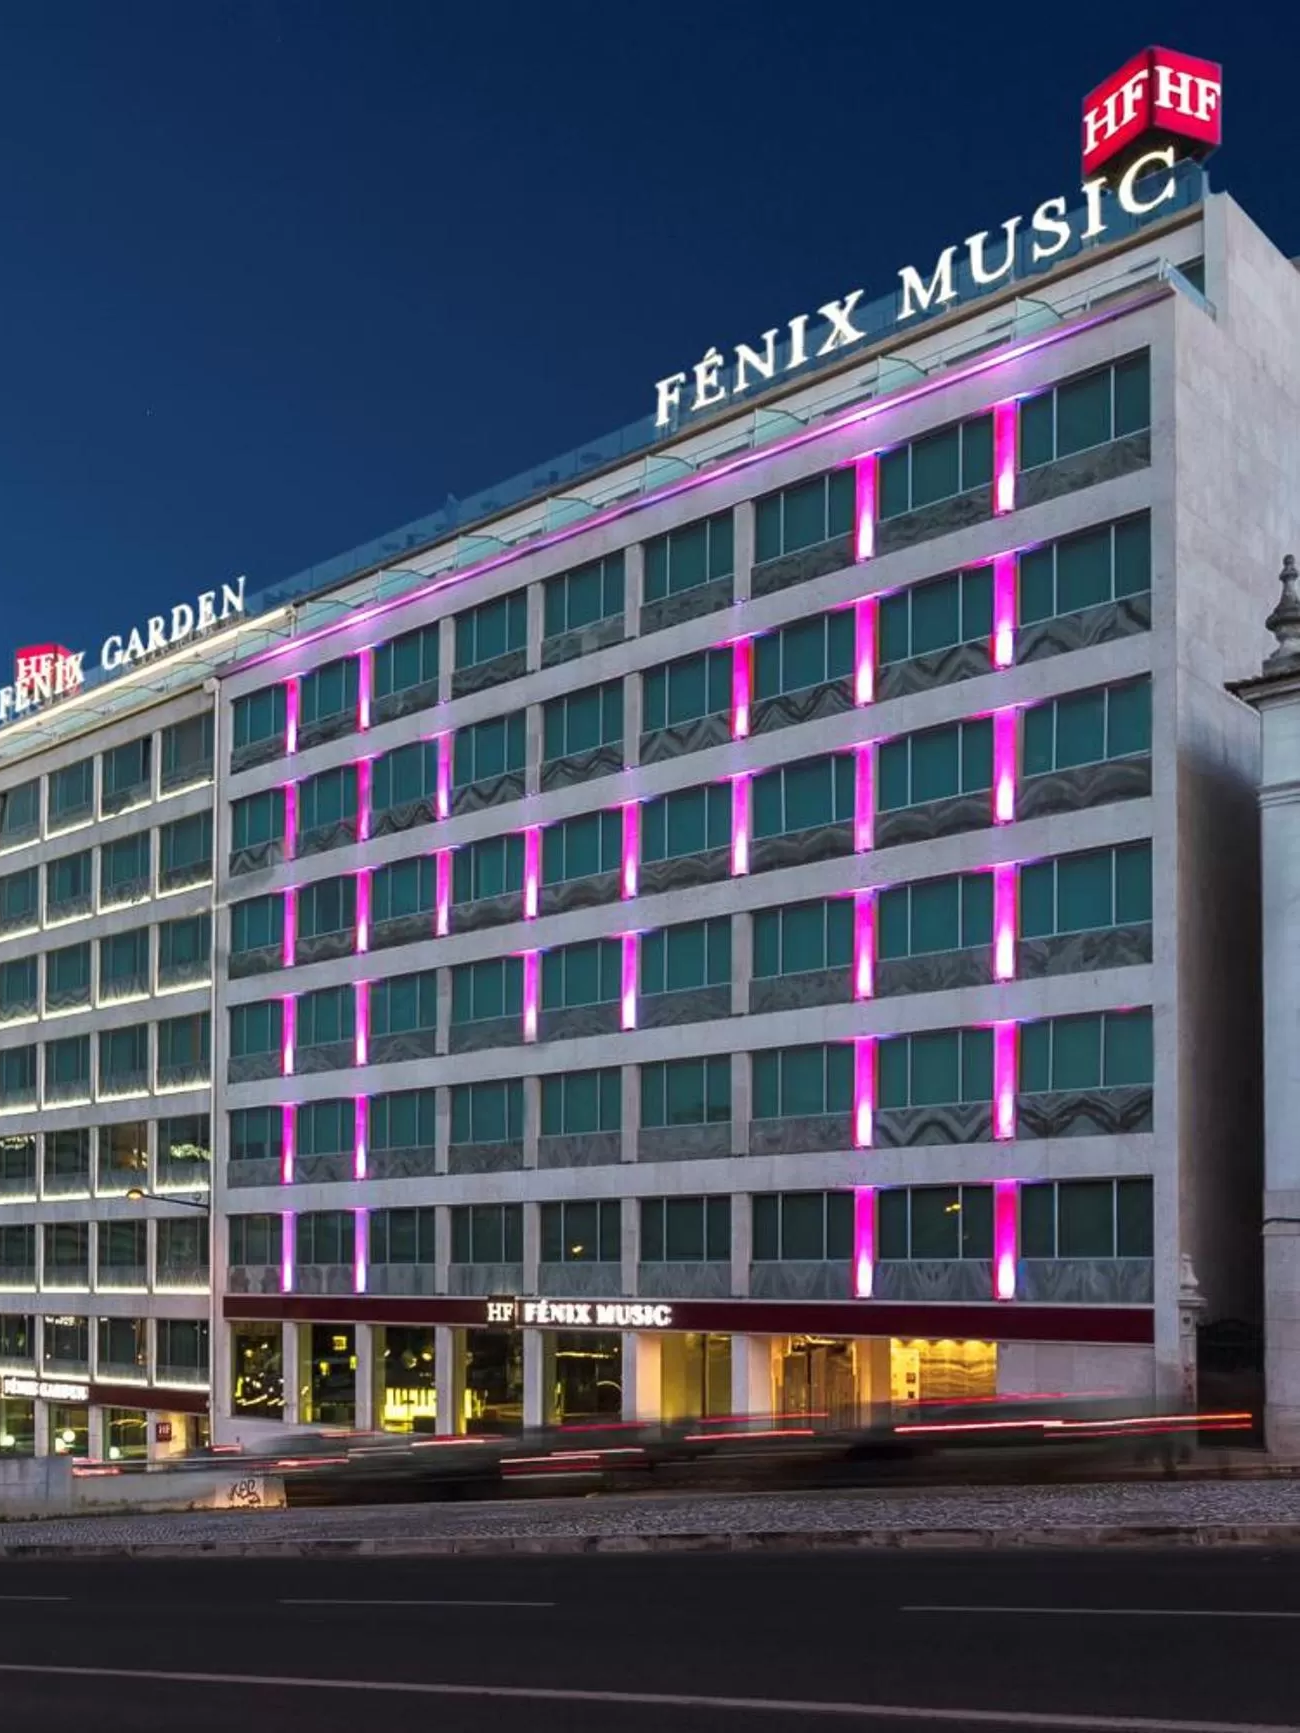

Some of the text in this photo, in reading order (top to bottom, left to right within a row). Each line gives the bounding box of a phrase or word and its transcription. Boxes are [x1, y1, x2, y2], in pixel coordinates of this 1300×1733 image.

[1083, 69, 1148, 156] HF
[1154, 64, 1221, 123] HF
[653, 146, 1177, 428] FÉNIX MUSIC
[101, 575, 246, 671] GARDEN
[487, 1299, 673, 1327] HF FÉNIX MUSIC
